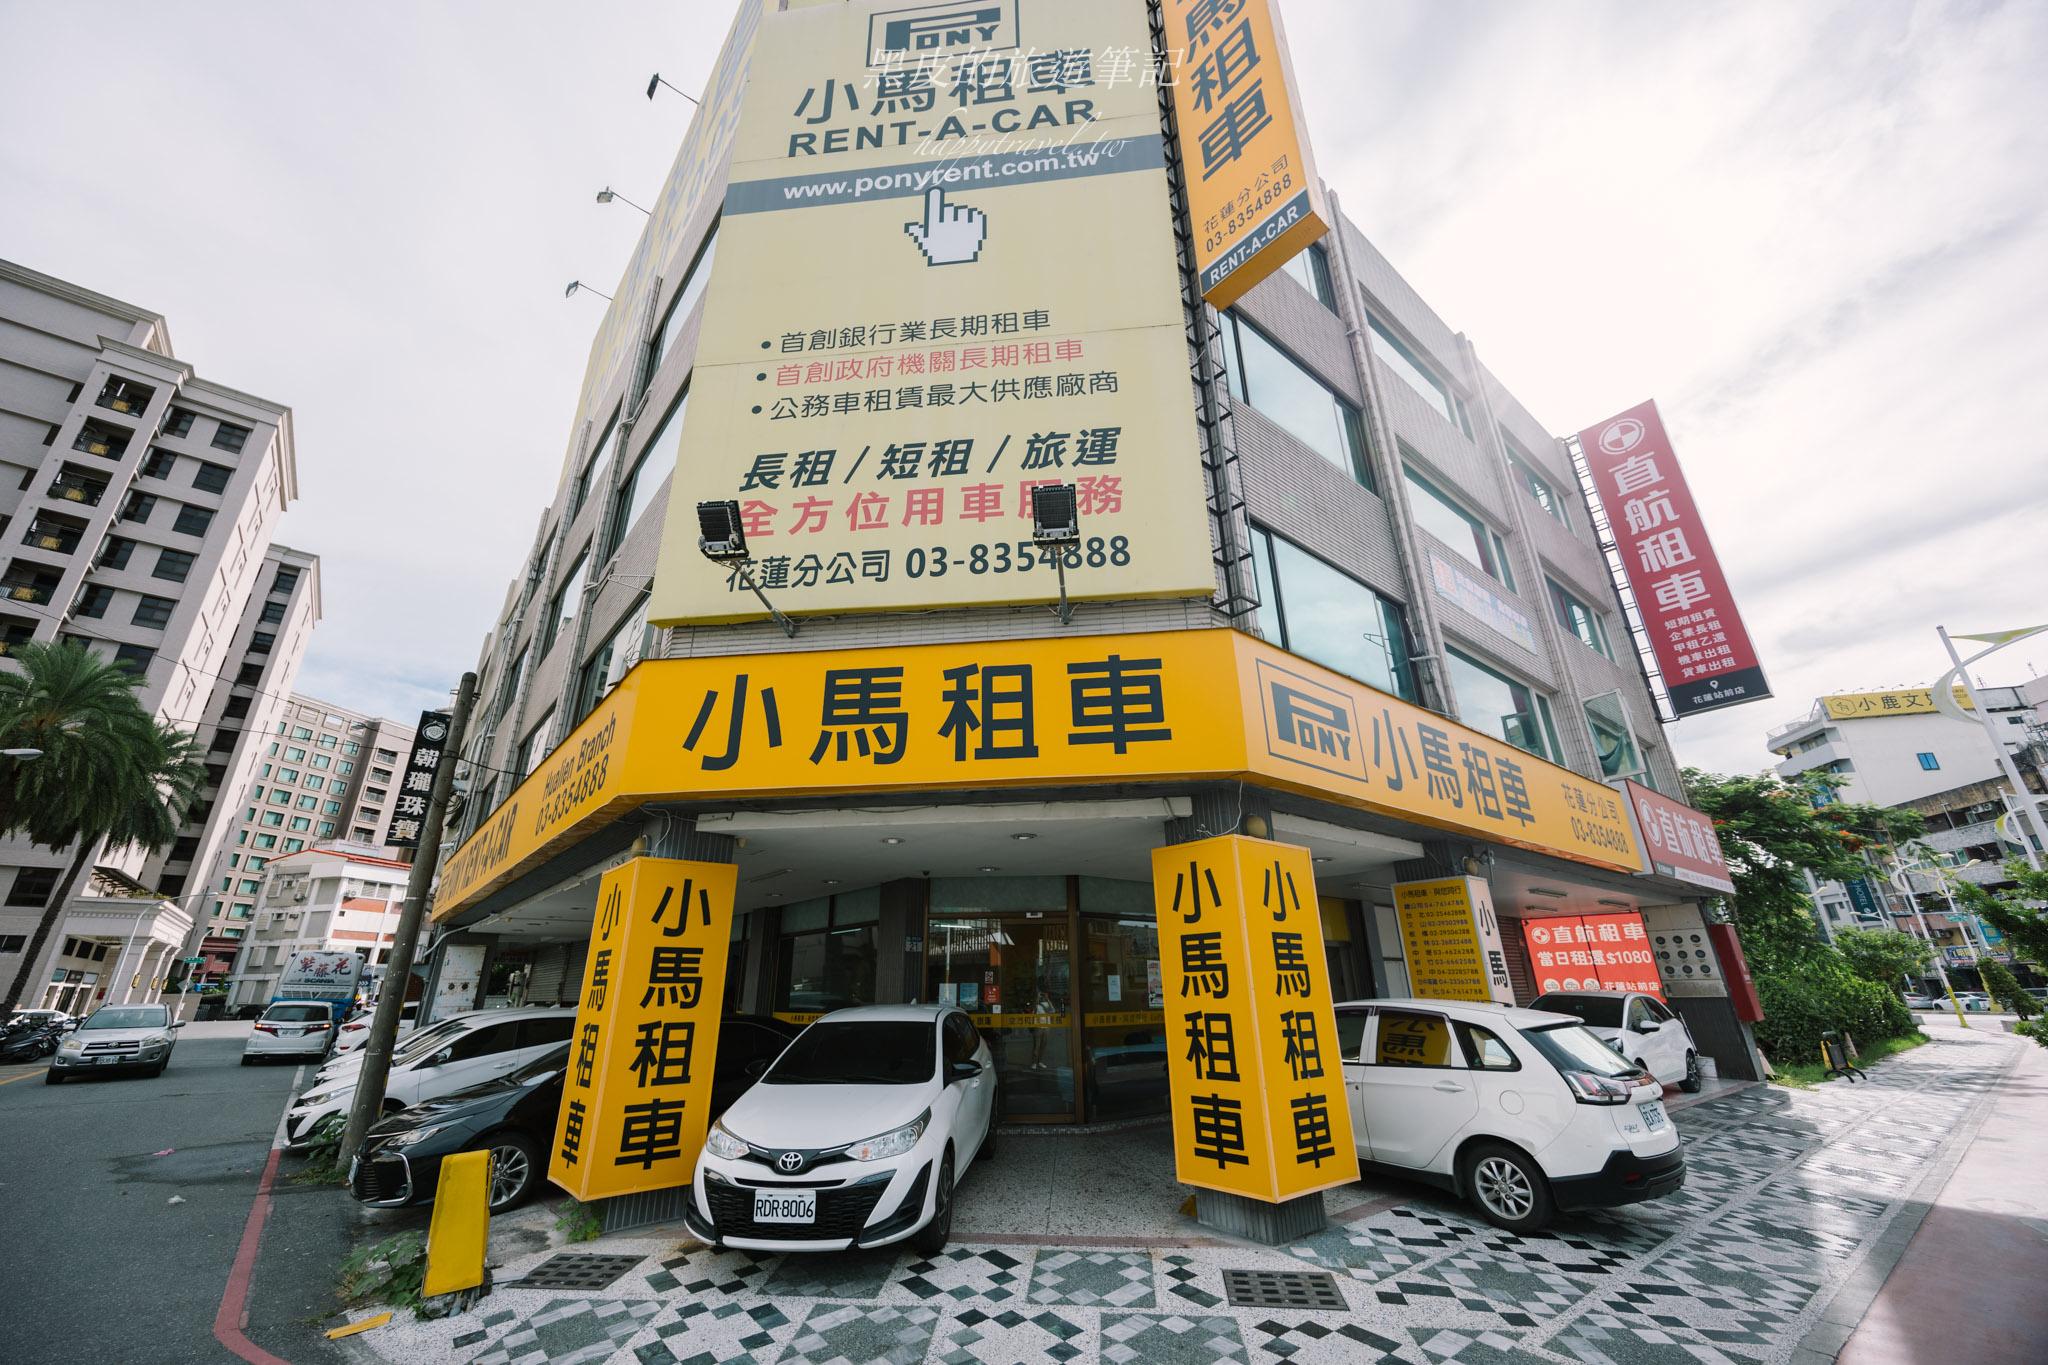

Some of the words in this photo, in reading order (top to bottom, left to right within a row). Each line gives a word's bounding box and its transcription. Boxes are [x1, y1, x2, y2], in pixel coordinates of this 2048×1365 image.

[793, 50, 1096, 127] 小馬租車
[788, 99, 1096, 158] RENT-A-CAR
[783, 148, 1100, 201] www.ponyrent.com.tw
[1204, 154, 1289, 233] 花蓮分公司
[1206, 174, 1292, 253] 03-8354888
[1210, 205, 1299, 286] RENT-A-CAR
[781, 309, 1052, 353] 首創銀行業長期租車
[776, 339, 1084, 387] 首創政府機關長期租車
[770, 370, 1119, 421] 公務車租賃最大供應廠商
[906, 535, 1131, 579] 03-8354888
[1608, 451, 1711, 613] 直航租車
[726, 549, 891, 593] 花蓮分公司
[1664, 608, 1717, 630] 短期租賃
[1669, 620, 1722, 642] 企業長租
[1674, 632, 1727, 652] 甲租乙還
[1682, 656, 1736, 678] 貨車出租
[1692, 686, 1745, 704] 花蓮站前店
[682, 655, 1172, 772] 小馬租車
[577, 711, 616, 773] Branch
[1372, 708, 1537, 829] 小馬租車
[1551, 922, 1646, 944] 直航租車
[299, 956, 351, 978] 紫藤花
[561, 882, 621, 1169] 小馬租車
[613, 878, 711, 1170] 小馬租車
[1172, 861, 1250, 1170] 小馬租車
[1263, 860, 1335, 1169] 小馬租車
